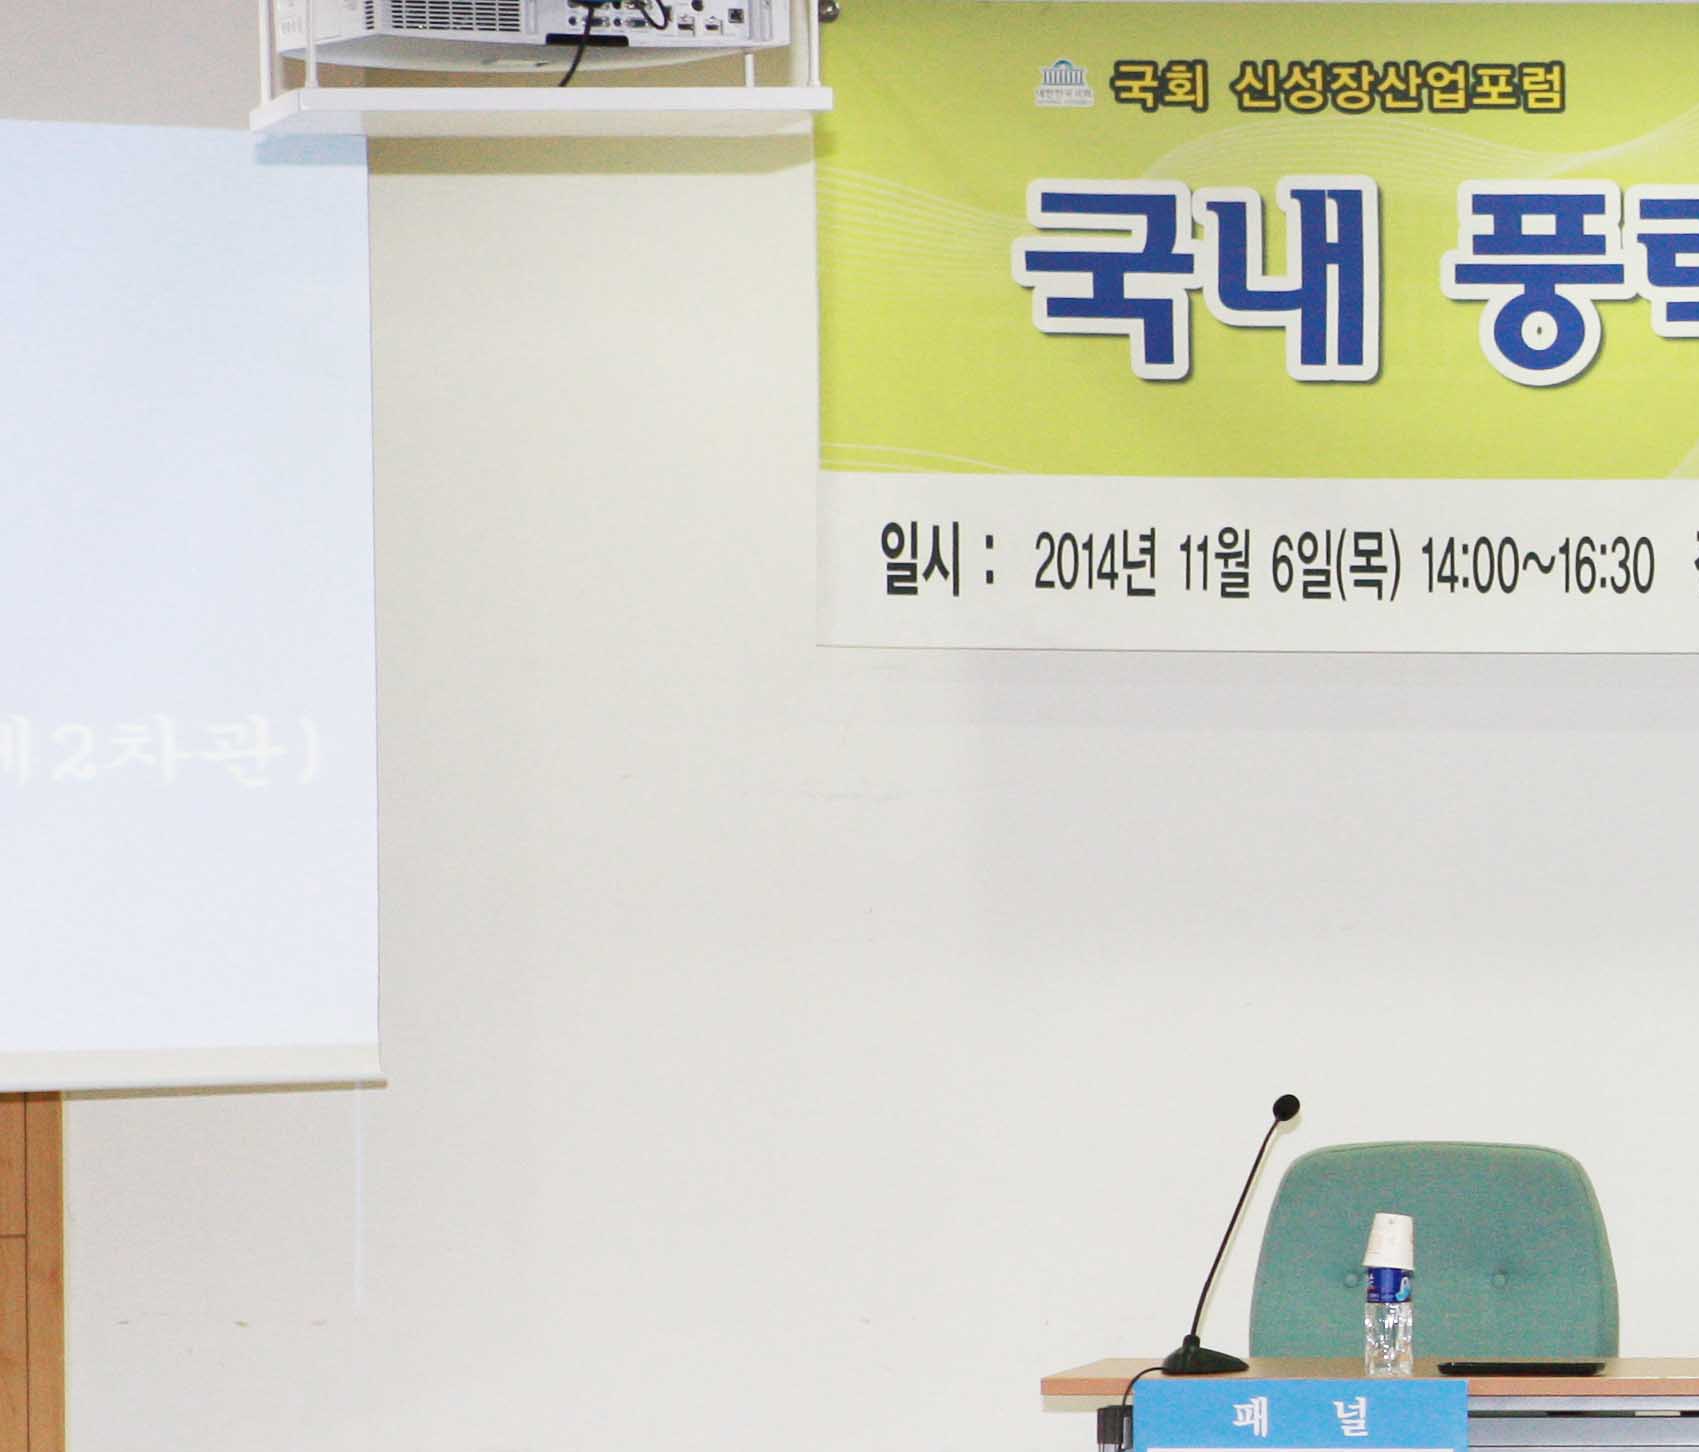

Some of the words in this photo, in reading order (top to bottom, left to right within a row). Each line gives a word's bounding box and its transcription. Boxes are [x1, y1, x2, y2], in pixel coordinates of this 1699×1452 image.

[1110, 60, 1208, 113] 국회
[1230, 60, 1565, 114] 신성장산업포럼
[1018, 180, 1375, 376] 국내
[880, 521, 961, 598] 일시
[1034, 527, 1157, 598] 2014년
[1178, 526, 1251, 599] 11월
[1271, 528, 1402, 601] 6일(목)
[1420, 535, 1656, 595] 14:00~16:30
